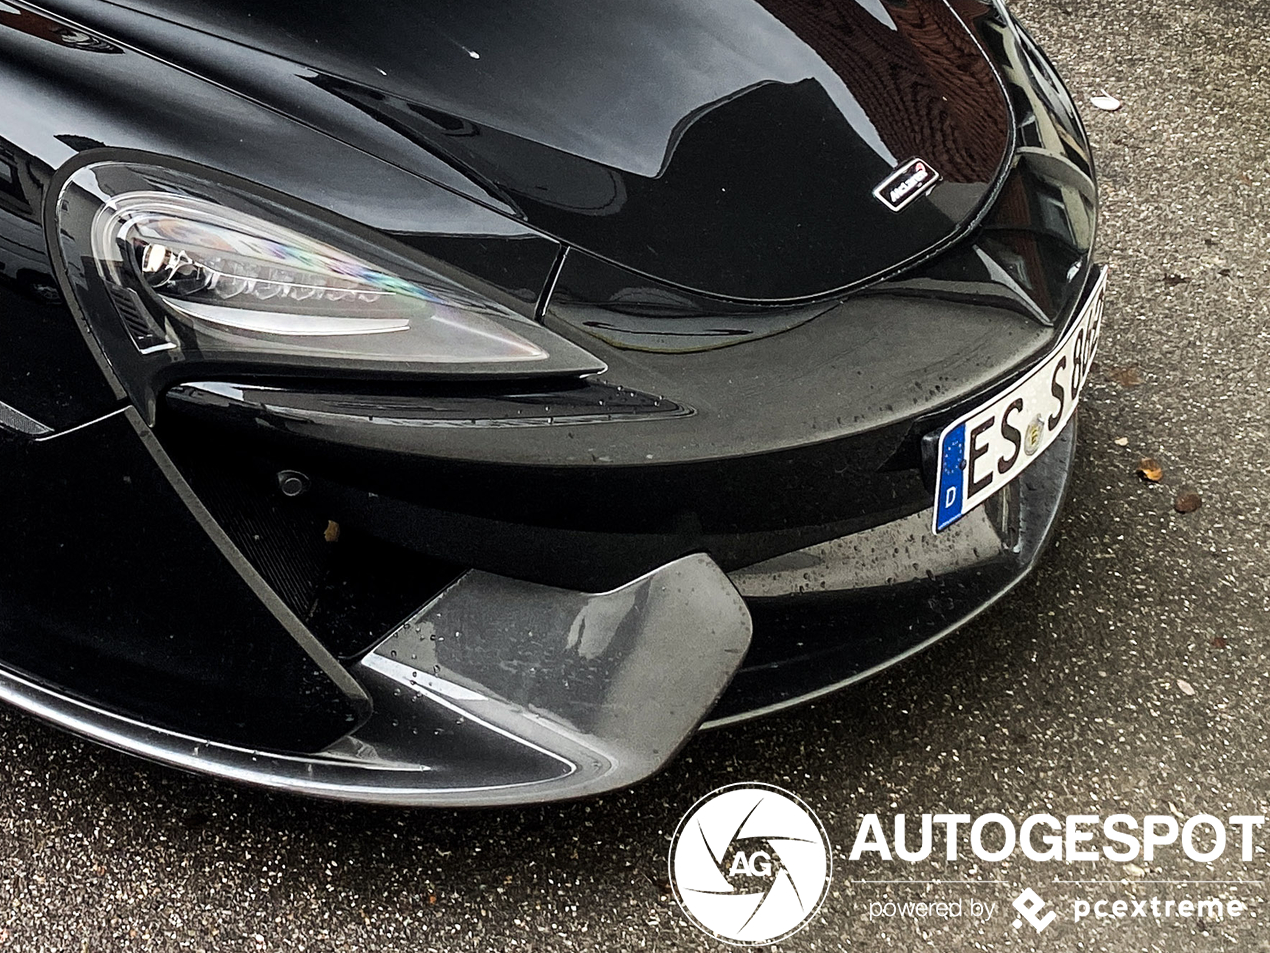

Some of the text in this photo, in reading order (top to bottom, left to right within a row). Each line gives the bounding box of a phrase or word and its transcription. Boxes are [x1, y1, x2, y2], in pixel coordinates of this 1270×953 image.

[967, 398, 1023, 500] ES
[1048, 355, 1067, 432] S
[945, 486, 957, 509] D
